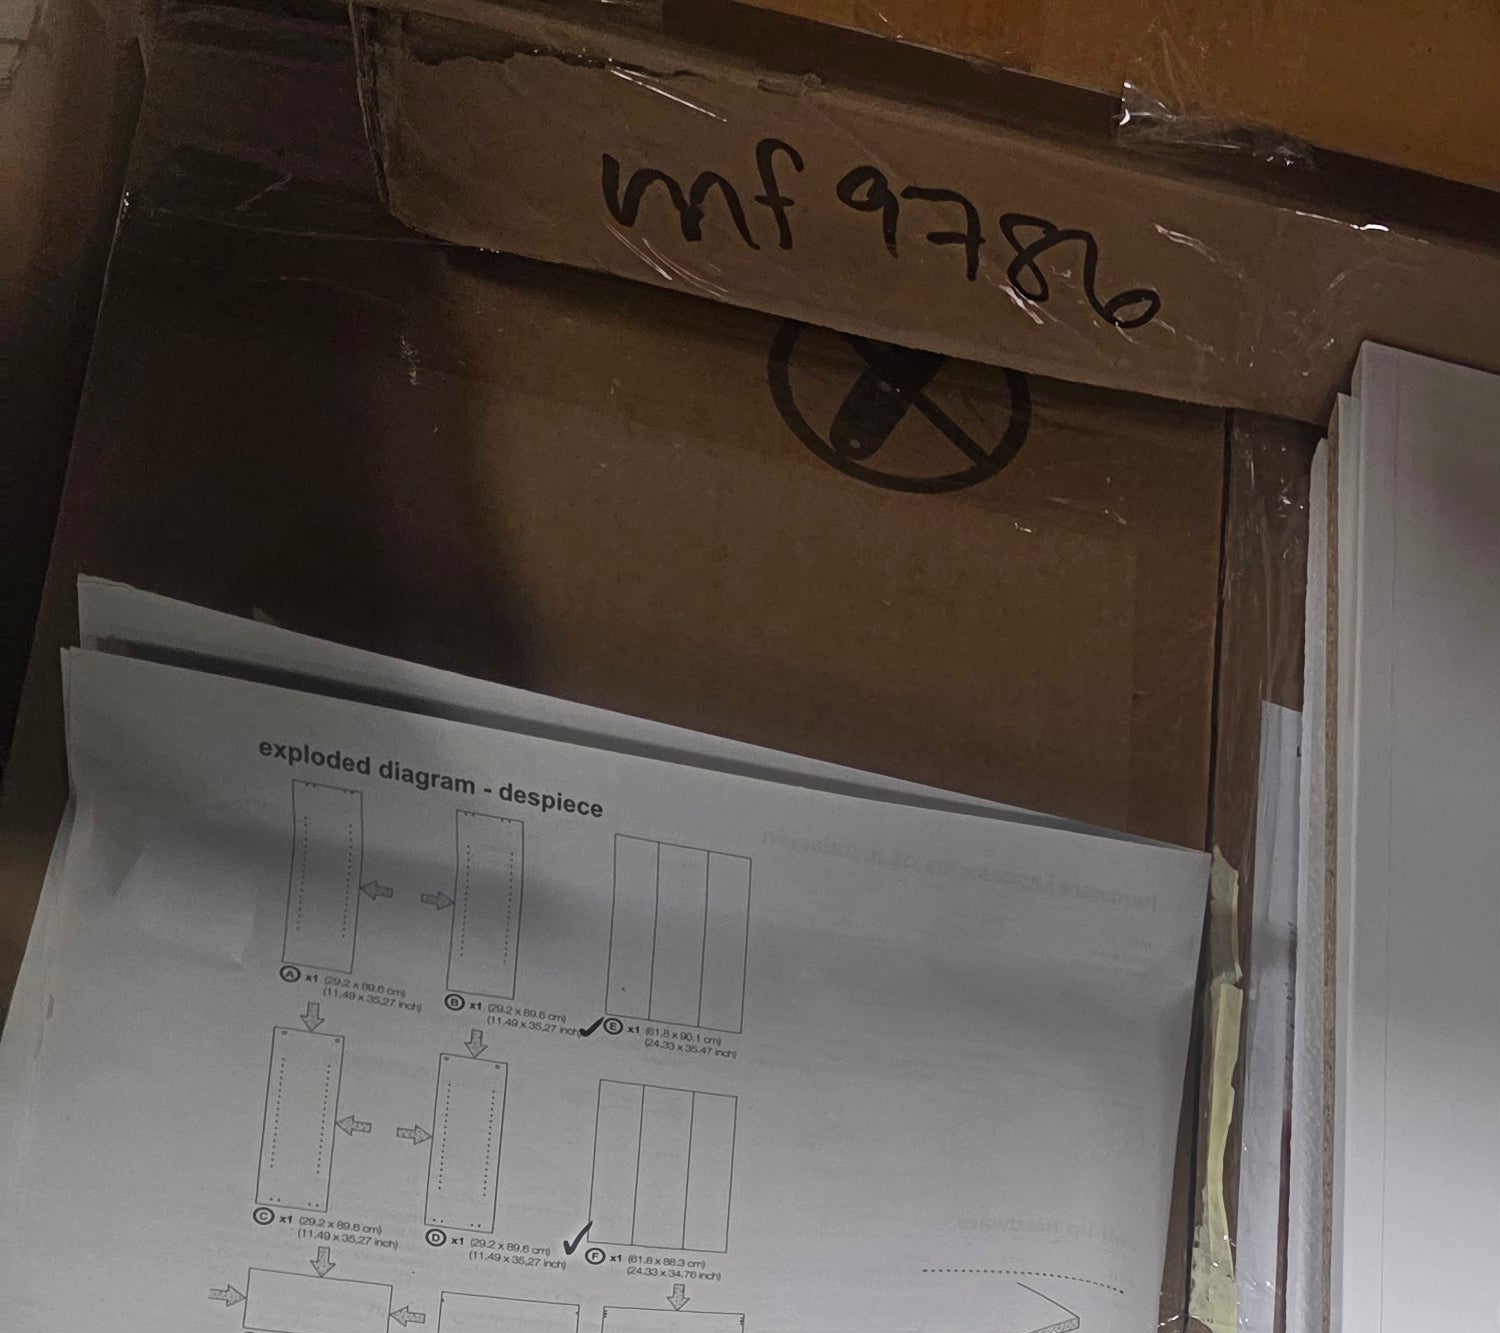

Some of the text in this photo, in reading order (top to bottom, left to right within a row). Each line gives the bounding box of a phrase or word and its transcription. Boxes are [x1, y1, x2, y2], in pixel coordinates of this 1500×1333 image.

[259, 741, 371, 776] exploded
[379, 760, 476, 795] diagram
[499, 783, 604, 818] despiece
[305, 974, 319, 983] x1
[469, 1002, 482, 1011] x1
[627, 1025, 640, 1034] x1
[279, 1215, 293, 1225] x1
[451, 1237, 464, 1246] x1
[609, 1254, 622, 1263] x1
